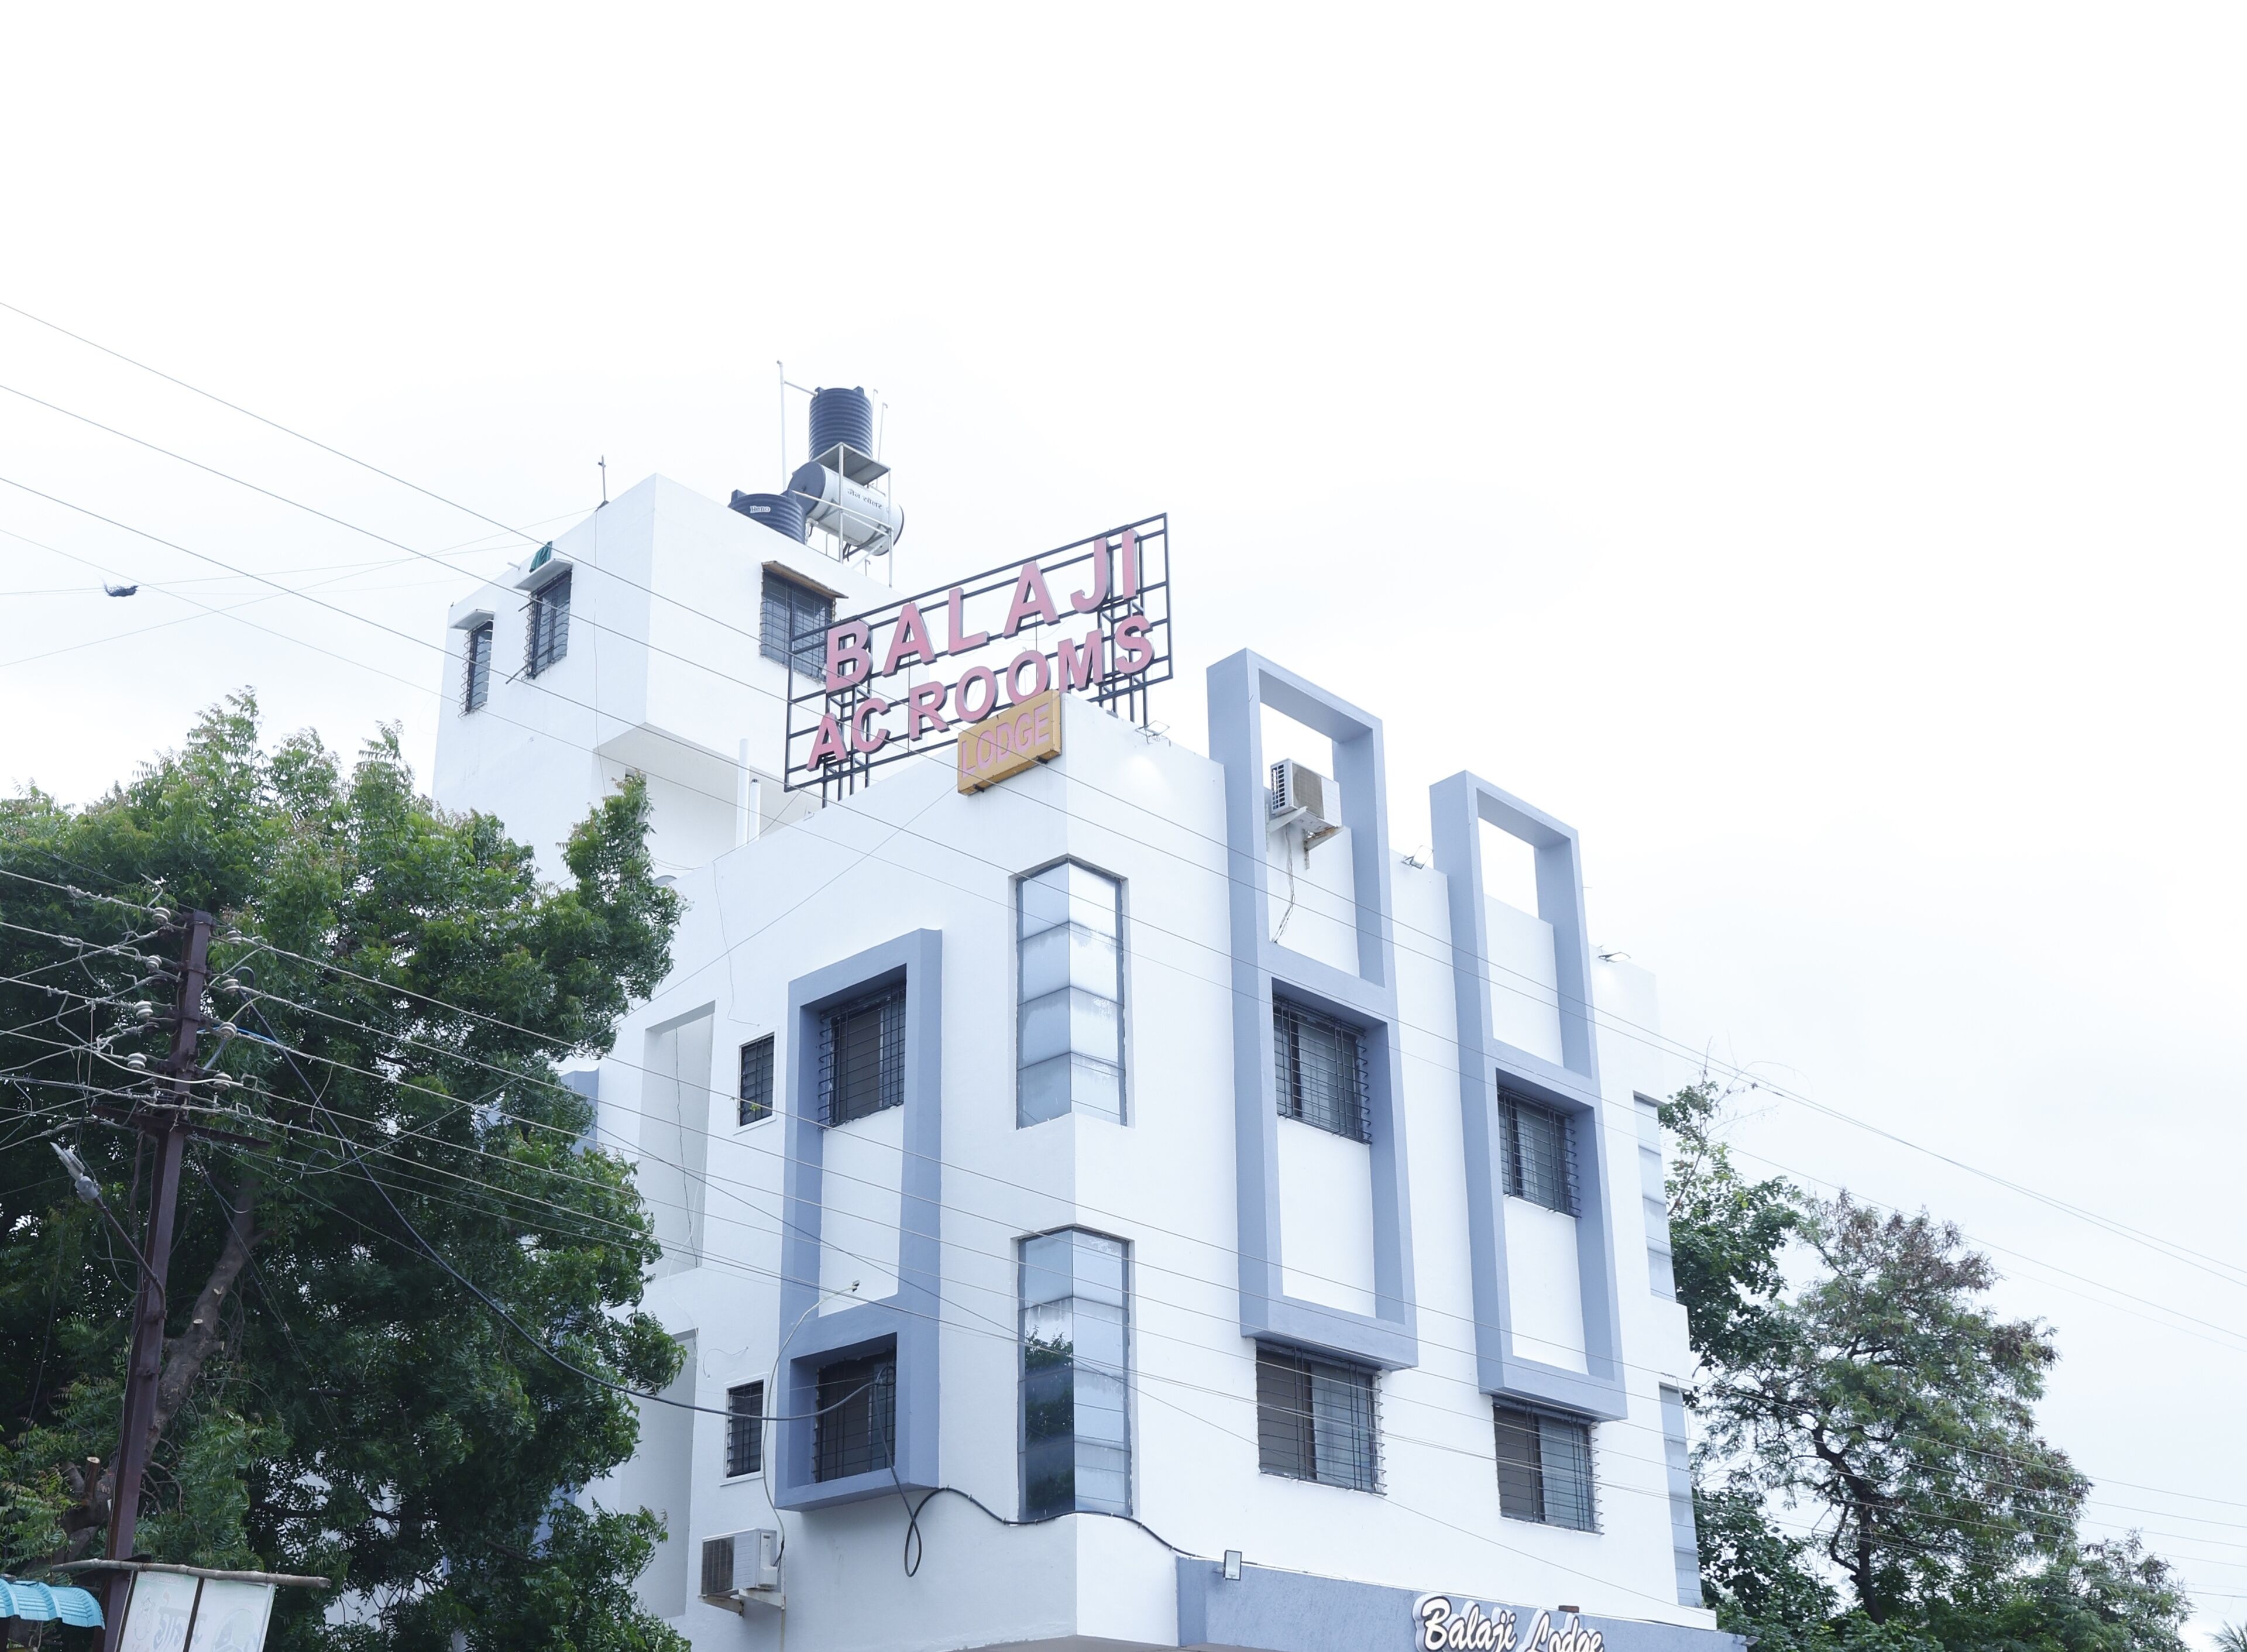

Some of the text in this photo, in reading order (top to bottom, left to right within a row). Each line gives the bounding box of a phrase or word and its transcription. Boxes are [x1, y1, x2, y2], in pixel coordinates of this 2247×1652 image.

[826, 529, 1140, 693] BALAJI
[807, 614, 1155, 772] AC ROOMS
[960, 703, 1050, 779] LODGE
[1417, 1594, 1518, 1651] Balaji
